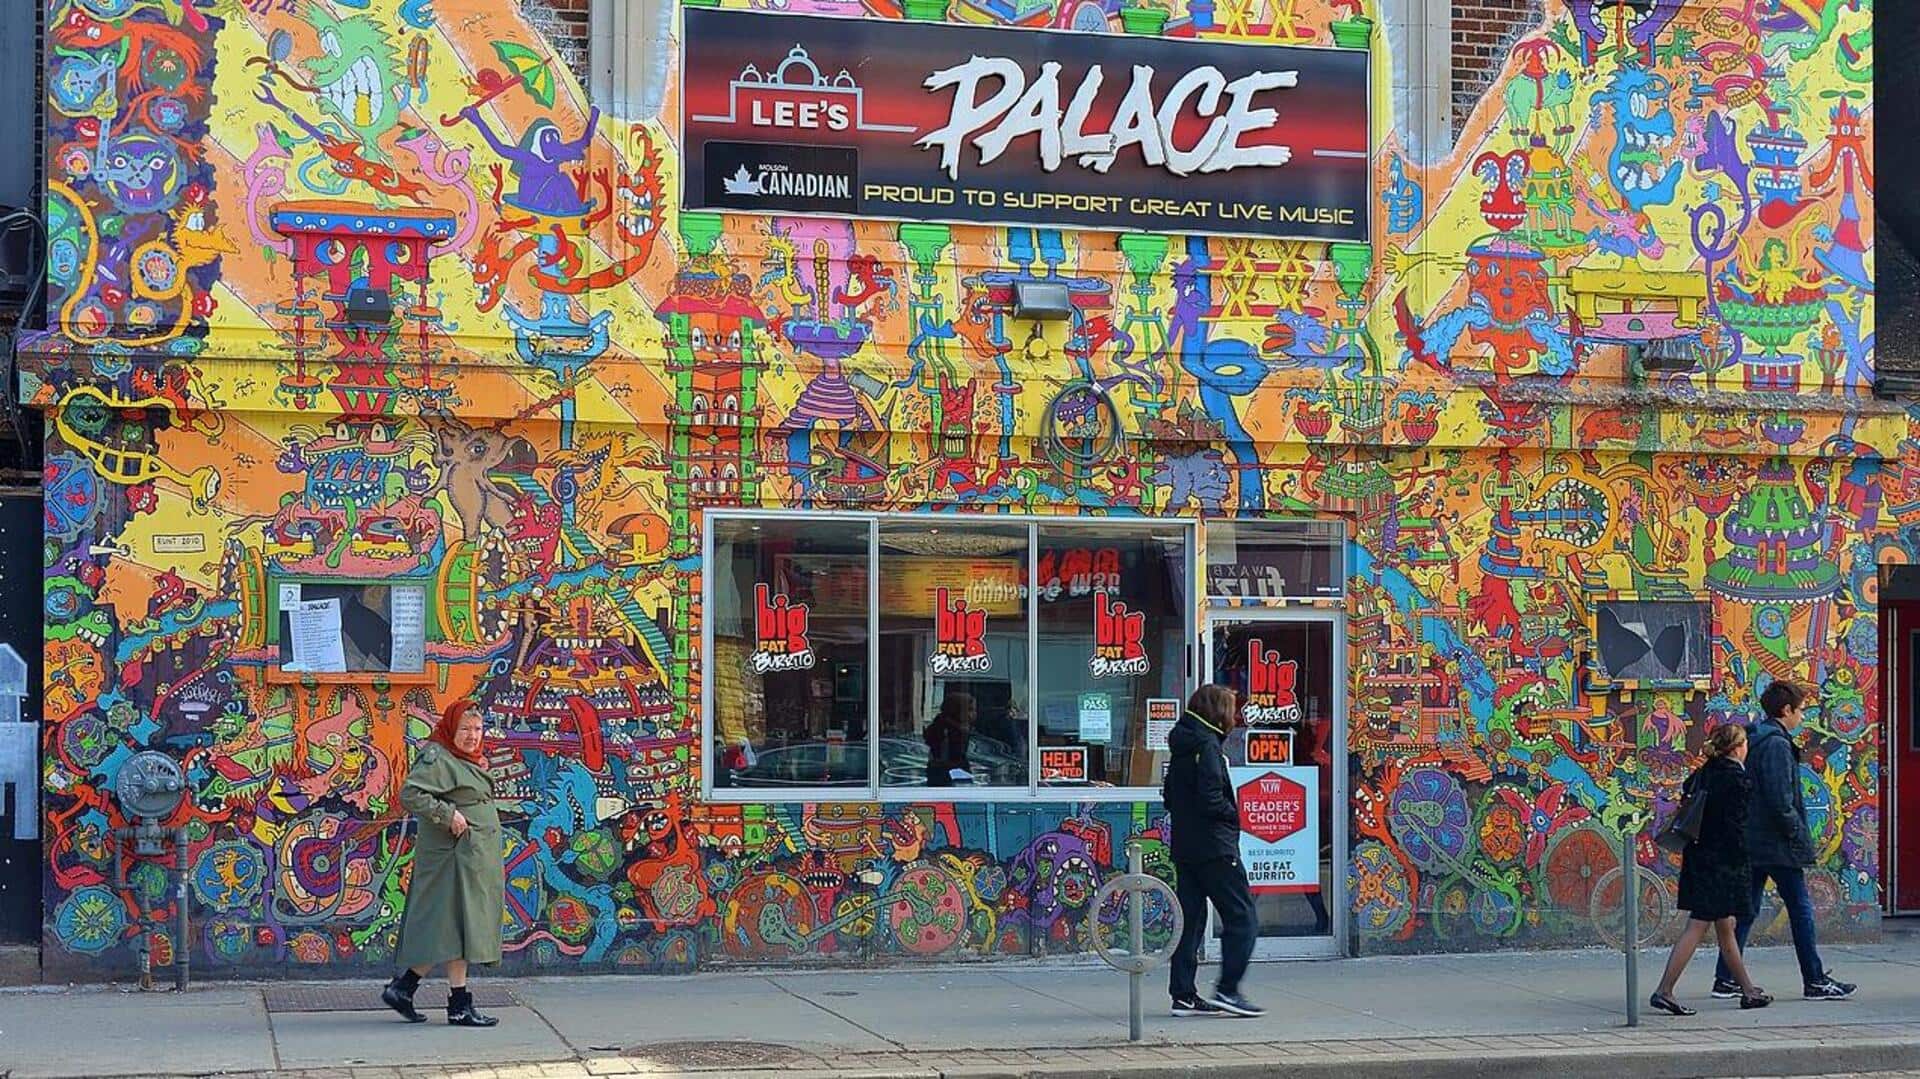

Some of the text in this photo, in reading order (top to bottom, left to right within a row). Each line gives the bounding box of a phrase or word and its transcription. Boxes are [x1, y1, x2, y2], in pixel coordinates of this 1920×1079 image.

[751, 54, 1299, 181] LEE'S PALACE
[758, 163, 789, 172] MOLSON
[757, 172, 850, 199] CANADIAN
[863, 184, 1354, 225] PROUD TO SUPPORT GREAT LIVE MUSIC
[757, 585, 806, 653] big
[937, 587, 986, 656] big
[1096, 592, 1142, 658] big
[759, 640, 787, 652] FAT
[938, 643, 965, 655] FAT
[1096, 646, 1124, 658] FAT
[1251, 641, 1295, 707] big
[1083, 699, 1108, 710] PASS
[1251, 694, 1276, 707] FAT
[1250, 740, 1289, 761] OPEN
[1042, 751, 1082, 767] HELP
[1243, 800, 1300, 812] READER'S
[1247, 812, 1296, 823] CHOICE
[1252, 861, 1292, 871] BIG FAT
[1248, 871, 1296, 880] BURRITO
